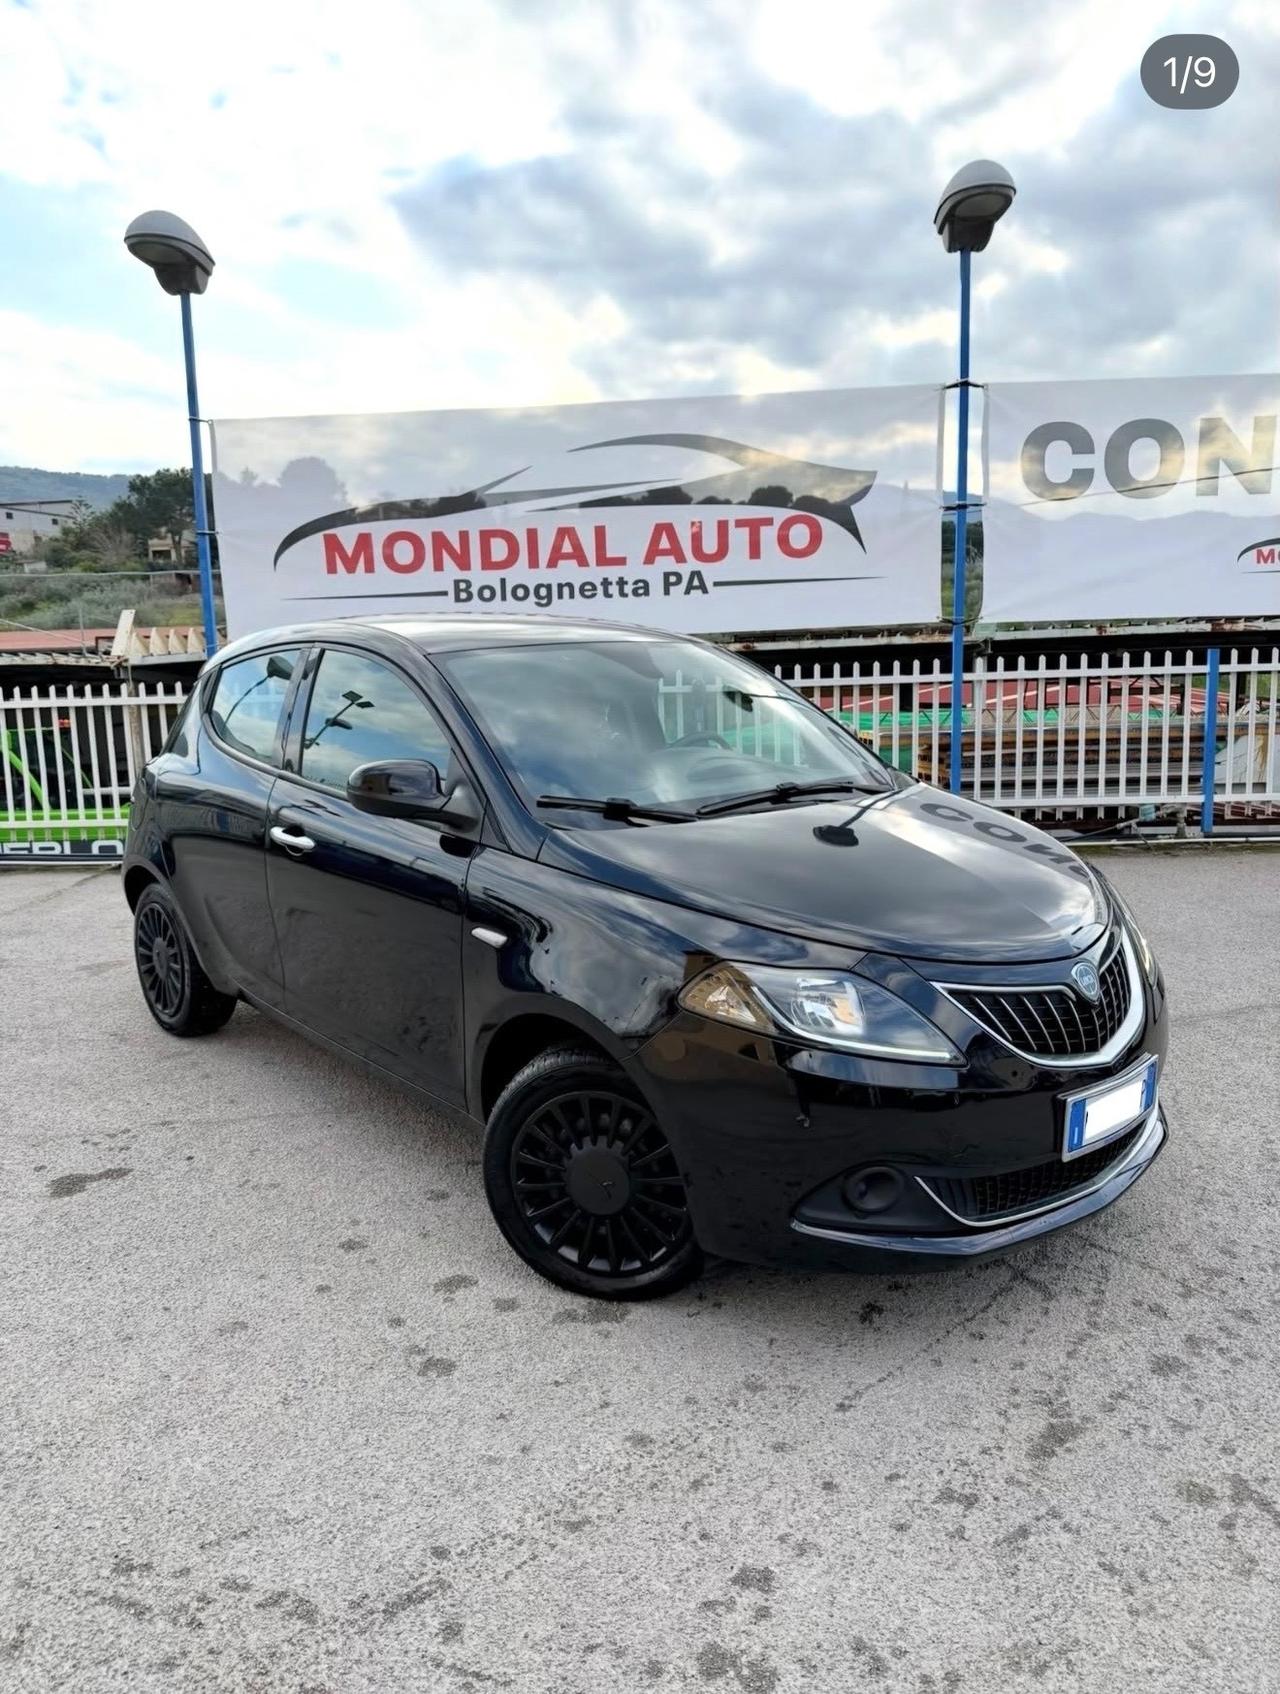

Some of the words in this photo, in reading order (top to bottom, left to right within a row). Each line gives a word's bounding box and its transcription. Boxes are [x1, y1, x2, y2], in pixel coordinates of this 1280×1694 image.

[1021, 415, 1278, 500] CON
[323, 525, 627, 575] MONDIAL
[643, 513, 823, 565] AUTO
[1256, 548, 1280, 564] M
[453, 577, 650, 608] Bolognetta
[662, 570, 710, 596] PA
